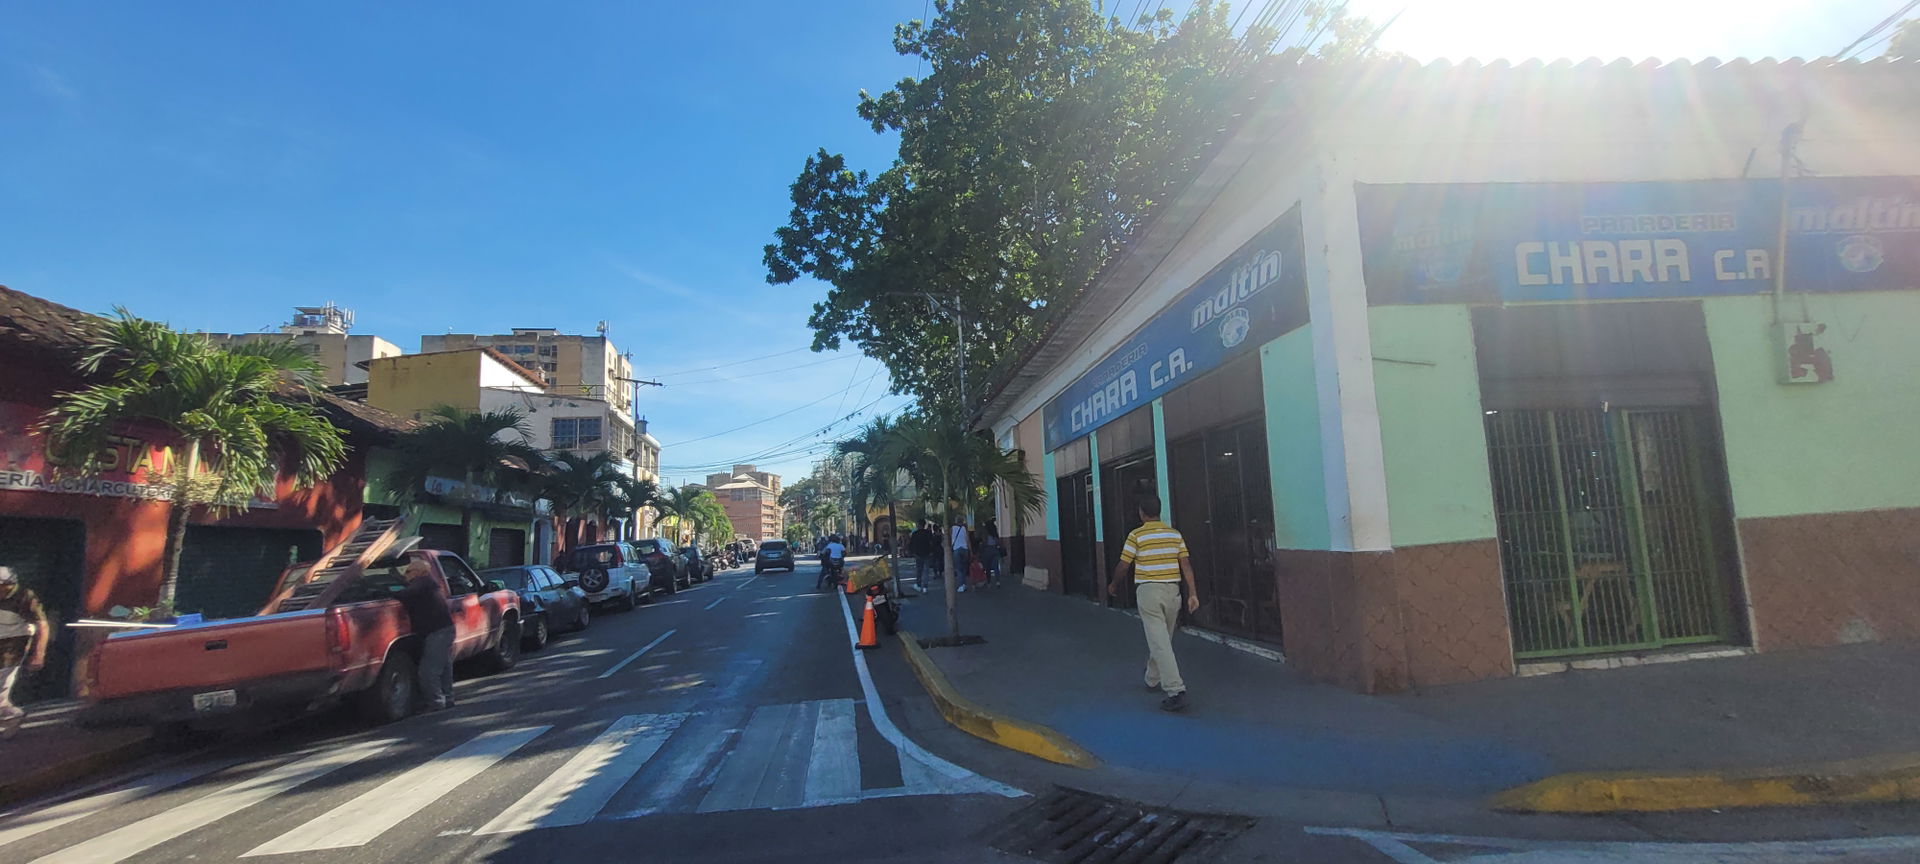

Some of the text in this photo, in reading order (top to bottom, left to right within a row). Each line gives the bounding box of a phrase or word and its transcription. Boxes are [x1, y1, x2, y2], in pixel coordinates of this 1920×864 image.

[1580, 212, 1737, 234] PANADERIA
[1515, 239, 1691, 286] CHARA
[1070, 347, 1193, 433] CHARA C.A.
